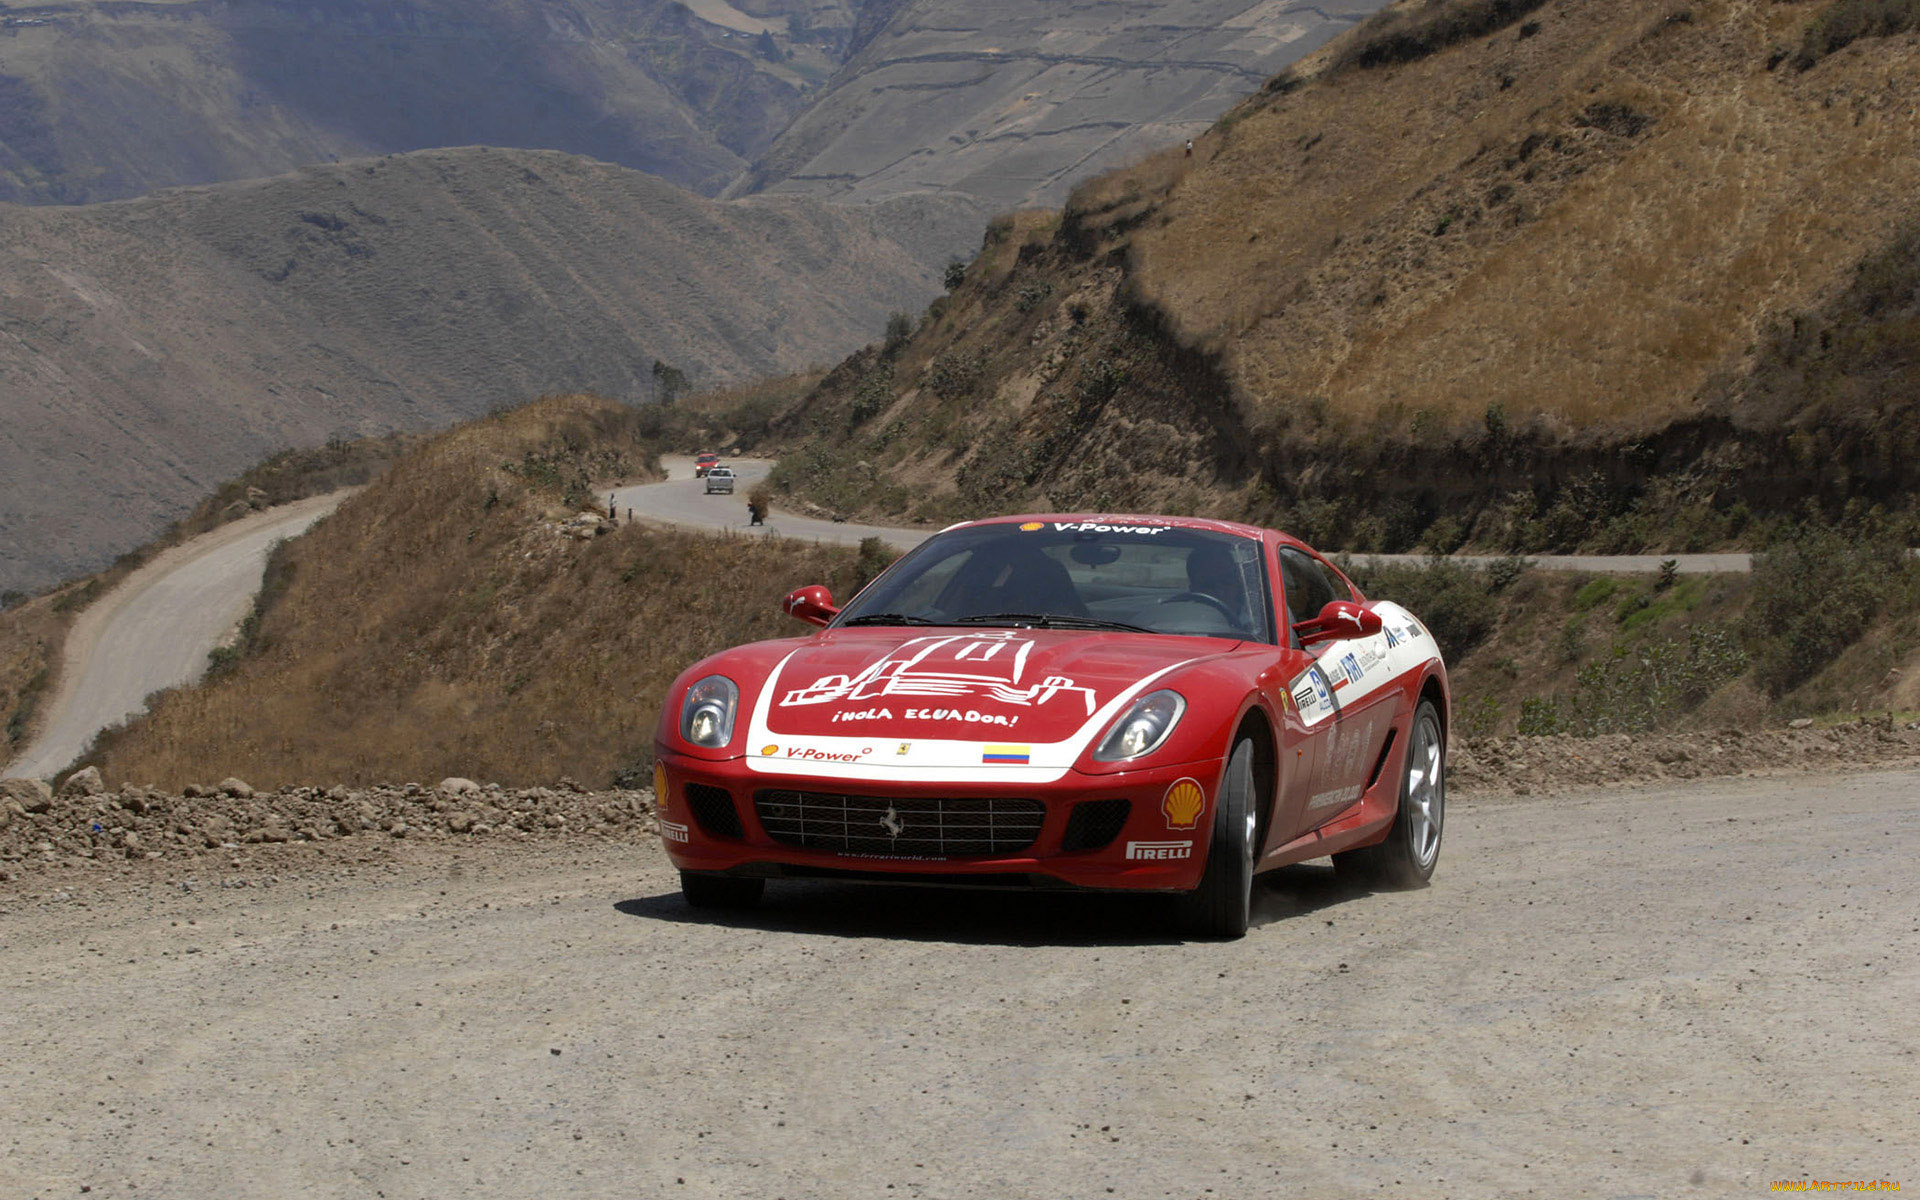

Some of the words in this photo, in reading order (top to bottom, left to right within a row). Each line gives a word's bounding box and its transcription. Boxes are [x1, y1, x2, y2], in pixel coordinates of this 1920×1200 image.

[1054, 522, 1163, 535] V-Power
[1340, 652, 1364, 684] FIAT
[1294, 686, 1317, 711] PIRELLI
[787, 747, 862, 762] V-Power
[1126, 840, 1193, 859] PIRELLI
